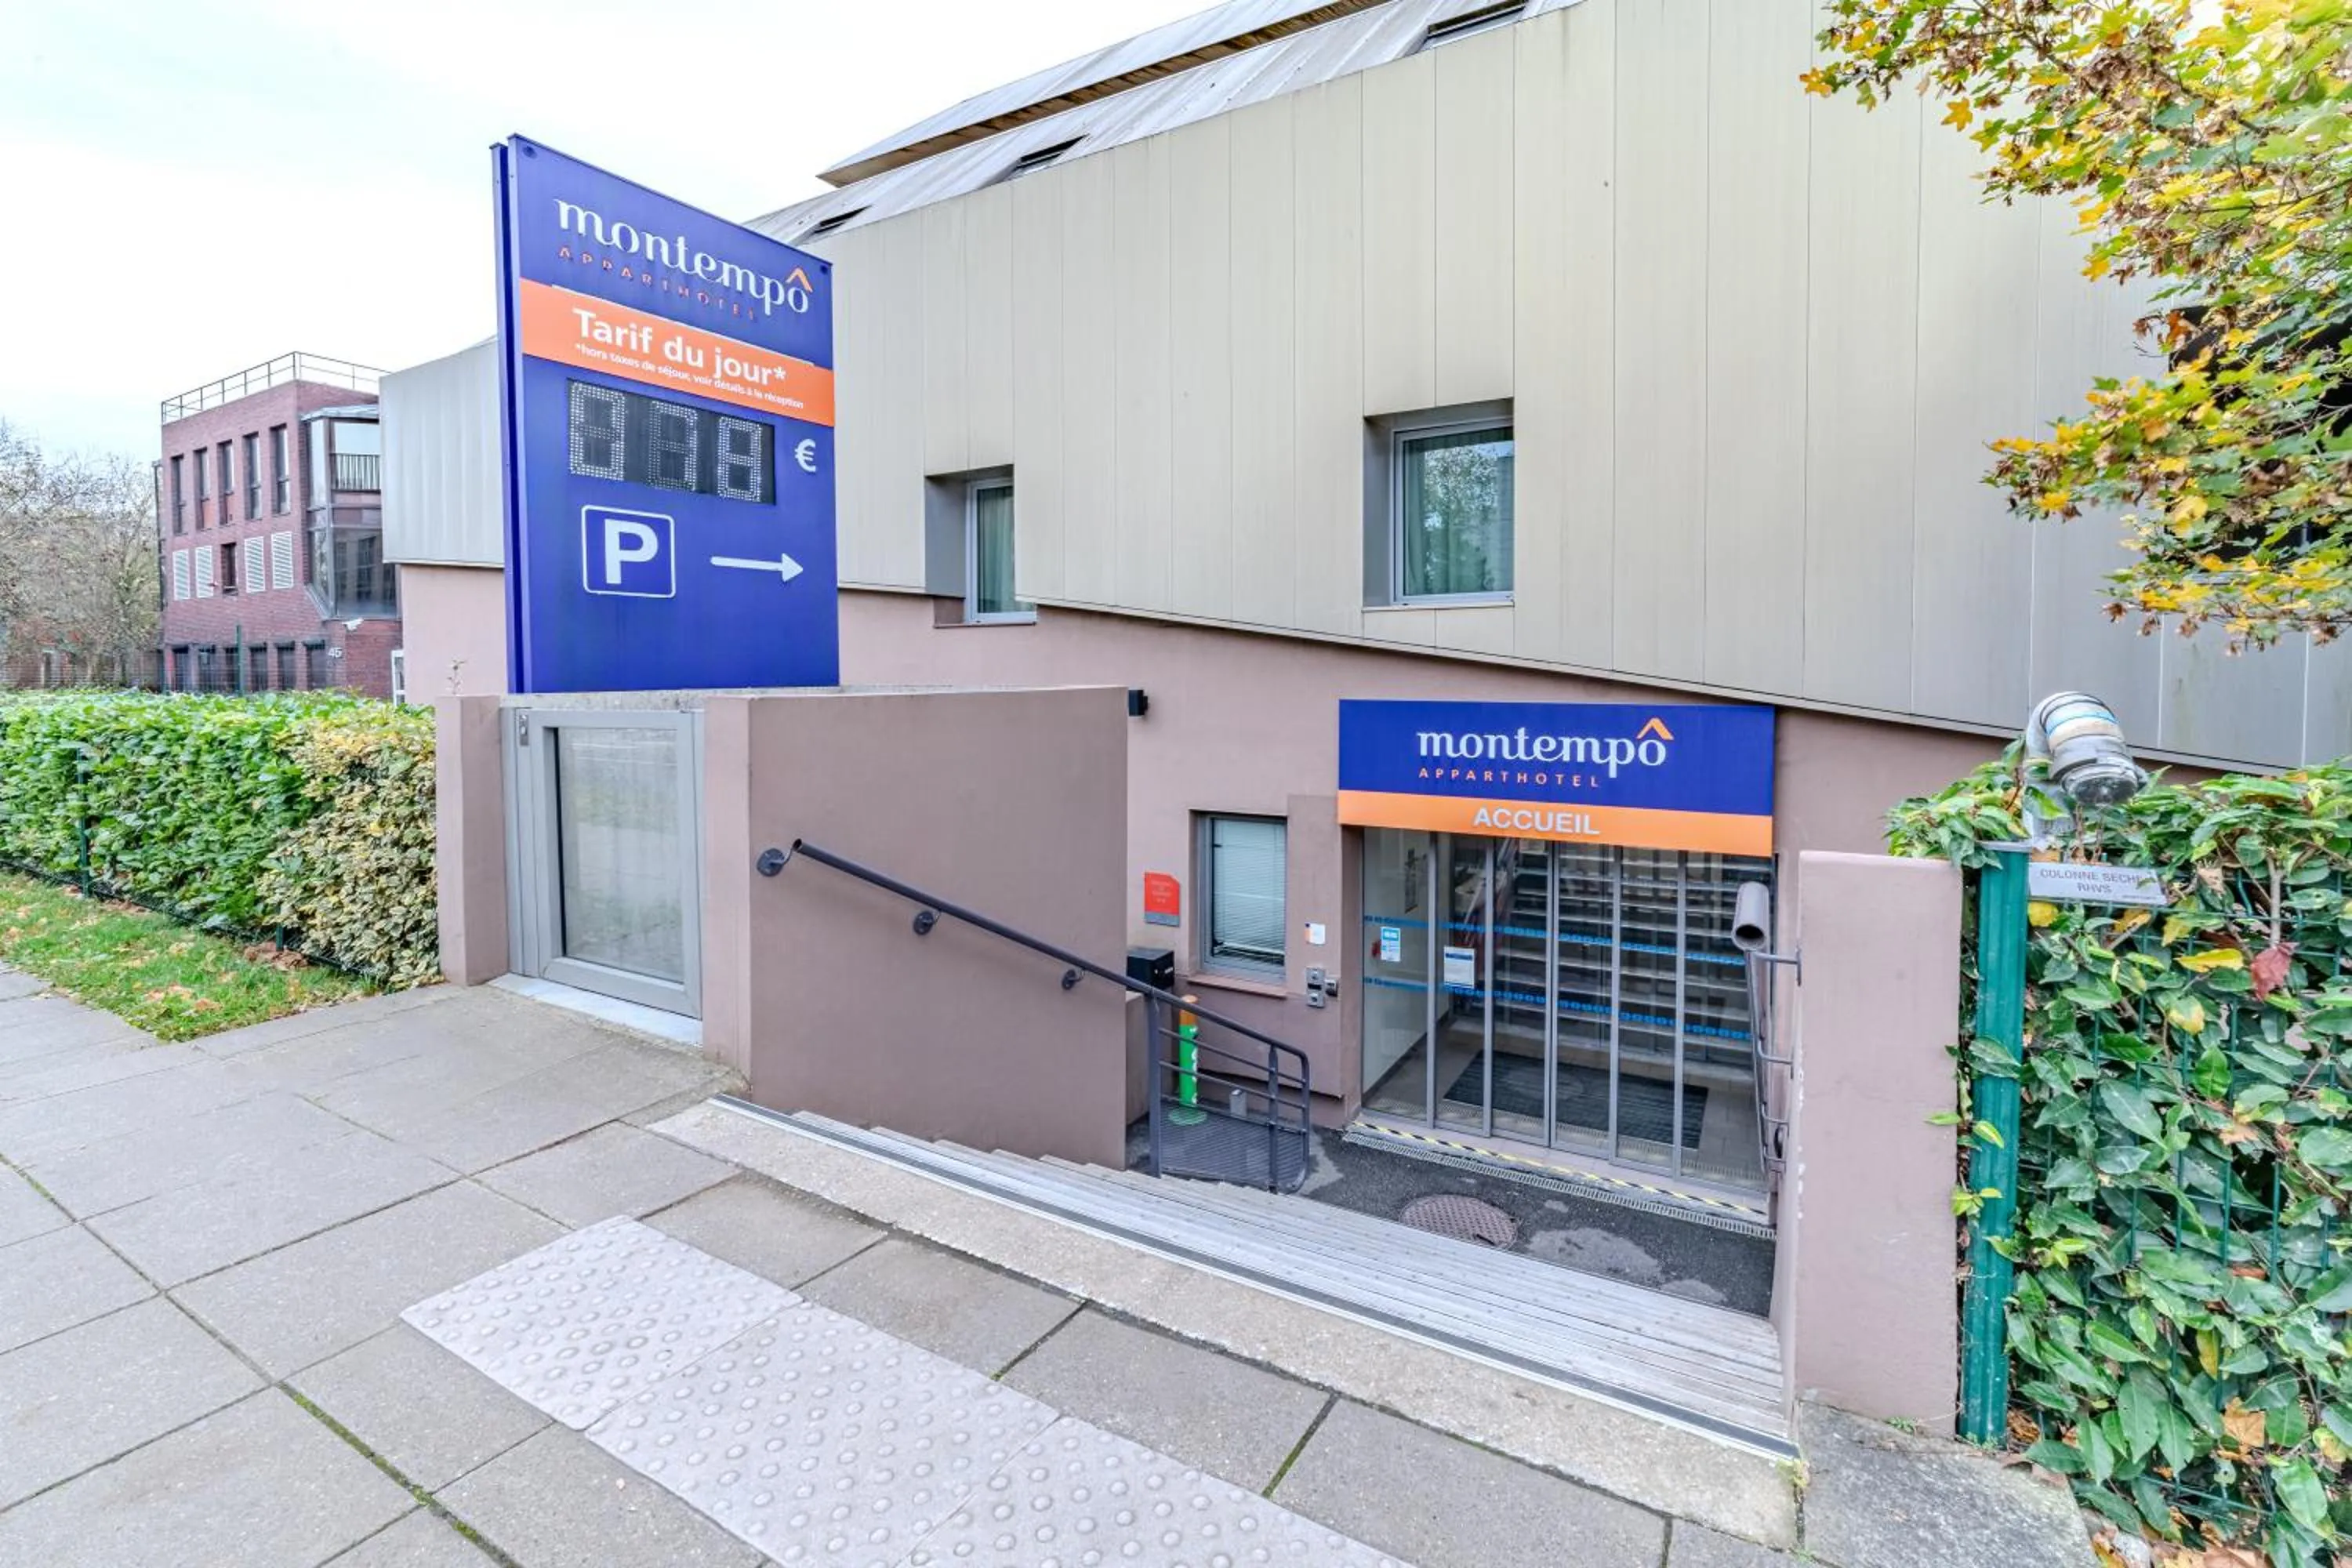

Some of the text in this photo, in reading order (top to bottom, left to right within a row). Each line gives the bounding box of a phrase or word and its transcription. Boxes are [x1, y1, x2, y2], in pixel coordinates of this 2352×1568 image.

[554, 198, 813, 315] montempô
[558, 245, 756, 320] APPARTHOTEL
[573, 307, 653, 354] Tarif
[663, 336, 704, 368] du
[641, 361, 656, 372] de
[693, 376, 713, 386] voir
[794, 438, 816, 472] €
[604, 518, 659, 584] P
[328, 647, 343, 658] 45
[1417, 717, 1674, 779] montempô
[1418, 767, 1599, 787] APPARTHOTEL
[1472, 806, 1600, 835] ACCUEIL
[2040, 868, 2099, 880] COLONNE
